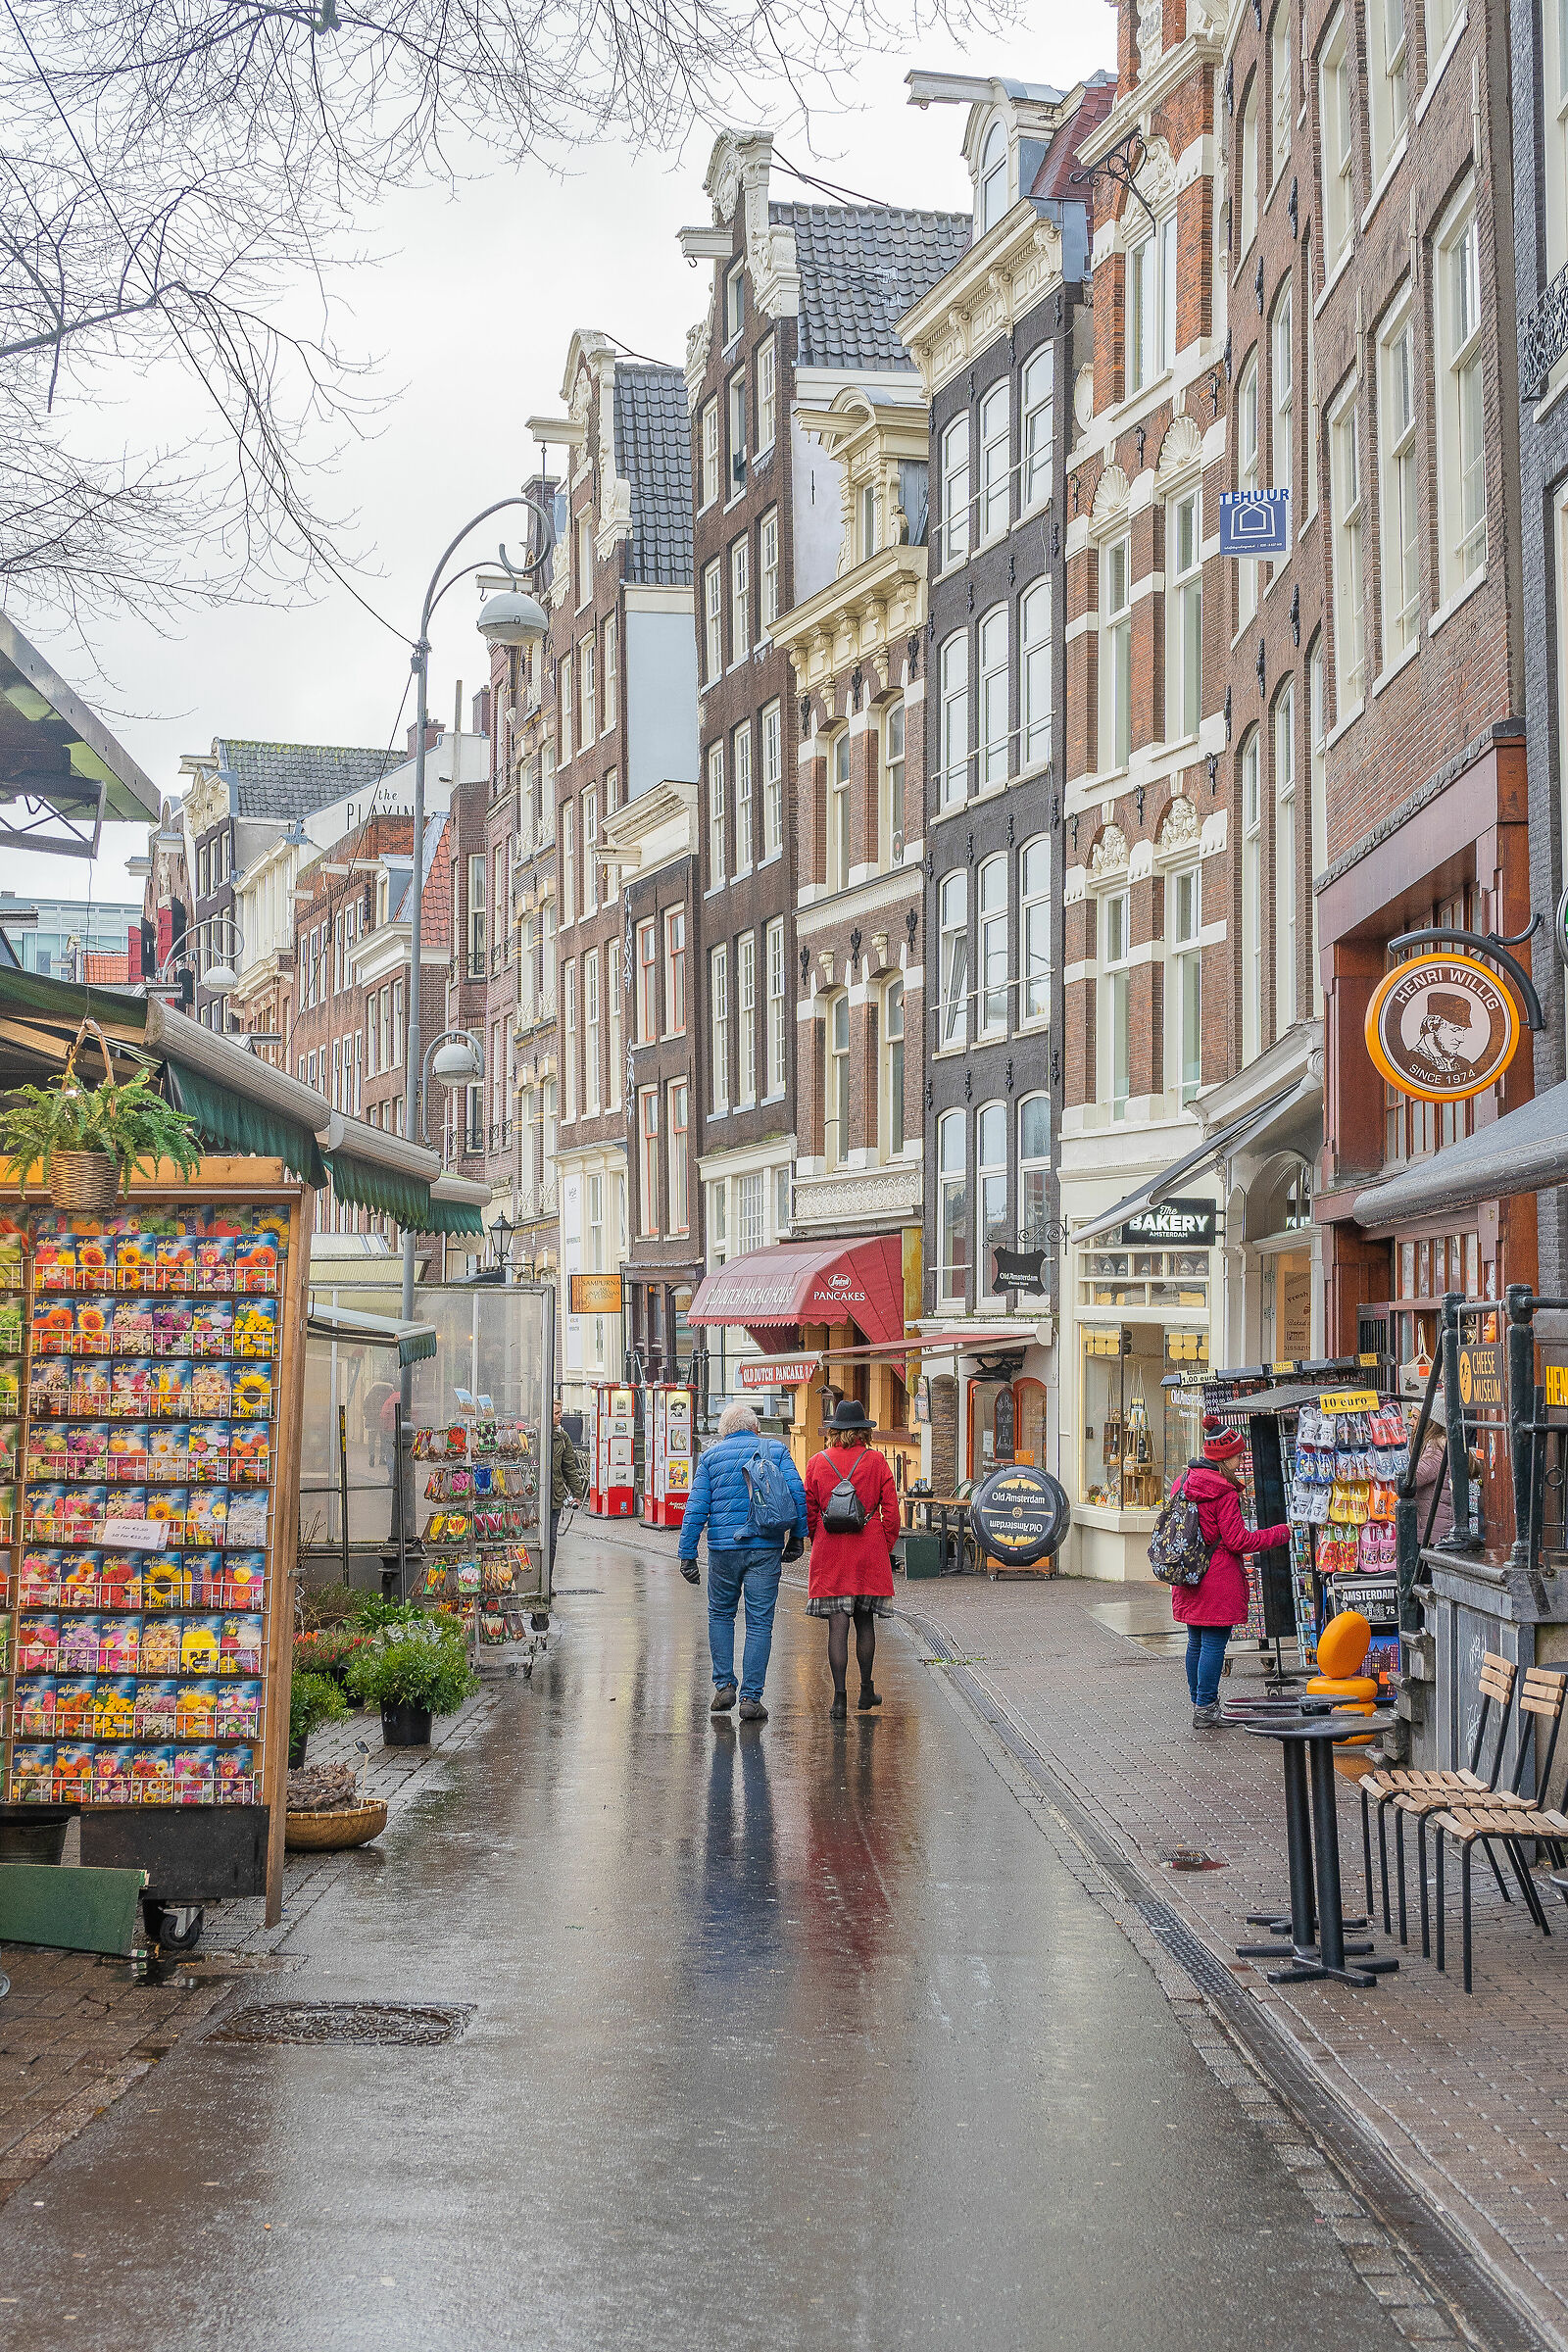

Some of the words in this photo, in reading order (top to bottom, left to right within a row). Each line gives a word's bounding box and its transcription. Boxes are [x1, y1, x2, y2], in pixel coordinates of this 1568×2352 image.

[378, 789, 398, 801] the
[1396, 969, 1444, 1004] HENRI
[1449, 968, 1499, 1010] WILLIG
[1408, 1063, 1442, 1085] SINCE
[1446, 1069, 1476, 1085] 1974
[1159, 1204, 1178, 1216] The
[1129, 1215, 1209, 1233] BAKERY
[813, 1291, 866, 1301] PANCAKES
[1472, 1351, 1495, 1375] CHEESE
[743, 1368, 754, 1383] OLD
[754, 1367, 773, 1383] DUTCH
[775, 1364, 805, 1381] PANCAKE
[1182, 1375, 1199, 1384] 1.00
[1473, 1379, 1501, 1402] MUSEUM
[1324, 1397, 1337, 1408] 10
[1340, 1397, 1368, 1406] euro
[992, 1492, 1004, 1502] Old
[1004, 1493, 1046, 1504] Amsterdam
[989, 1519, 1030, 1532] Amsterdam
[1029, 1521, 1043, 1533] Old
[1342, 1589, 1396, 1601] AMSTERDAM
[1385, 1605, 1396, 1615] 75
